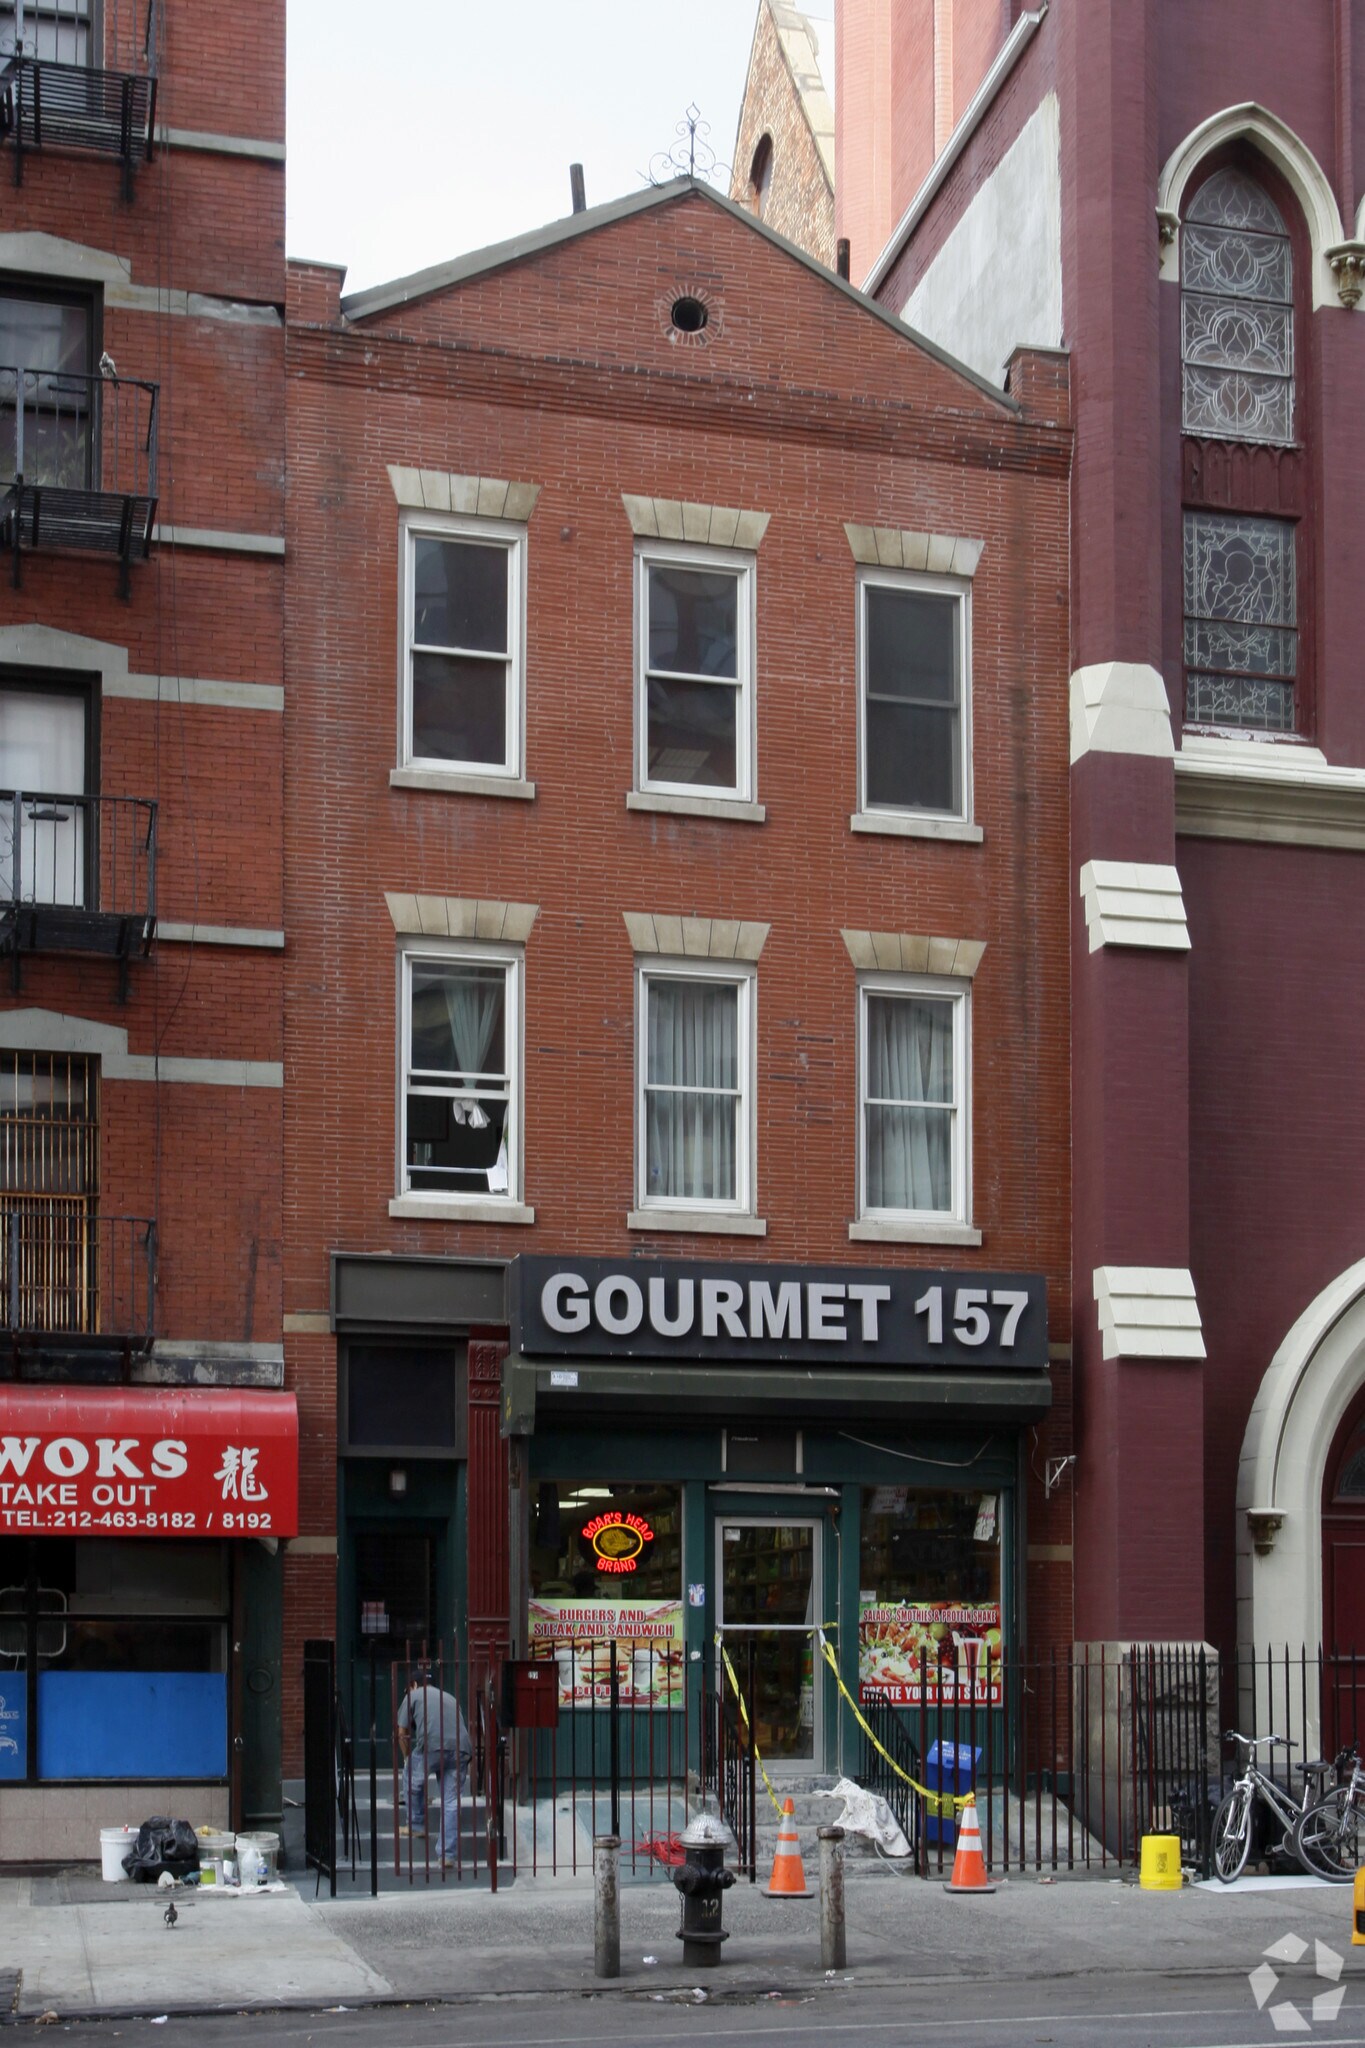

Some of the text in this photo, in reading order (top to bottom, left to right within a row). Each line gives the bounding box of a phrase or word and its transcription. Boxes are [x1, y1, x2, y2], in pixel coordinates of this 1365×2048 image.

[541, 1272, 1029, 1347] GOURMET 157
[0, 1436, 188, 1479] WOKS
[213, 1445, 269, 1502] 龍
[0, 1483, 157, 1507] TAKE OUT
[2, 1510, 196, 1529] TEL:212-463-8182
[222, 1512, 272, 1529] 8192
[582, 1512, 654, 1541] BOAR'S HEAD
[597, 1557, 637, 1573] BRAND
[559, 1608, 646, 1623] BURGERS AND
[863, 1608, 997, 1623] SALADS SMOTHIES & PROTEIN SHAKE
[534, 1623, 674, 1638] STEAK AND SANDWICH
[862, 1686, 902, 1700] CREATE
[701, 1898, 720, 1917] 12
